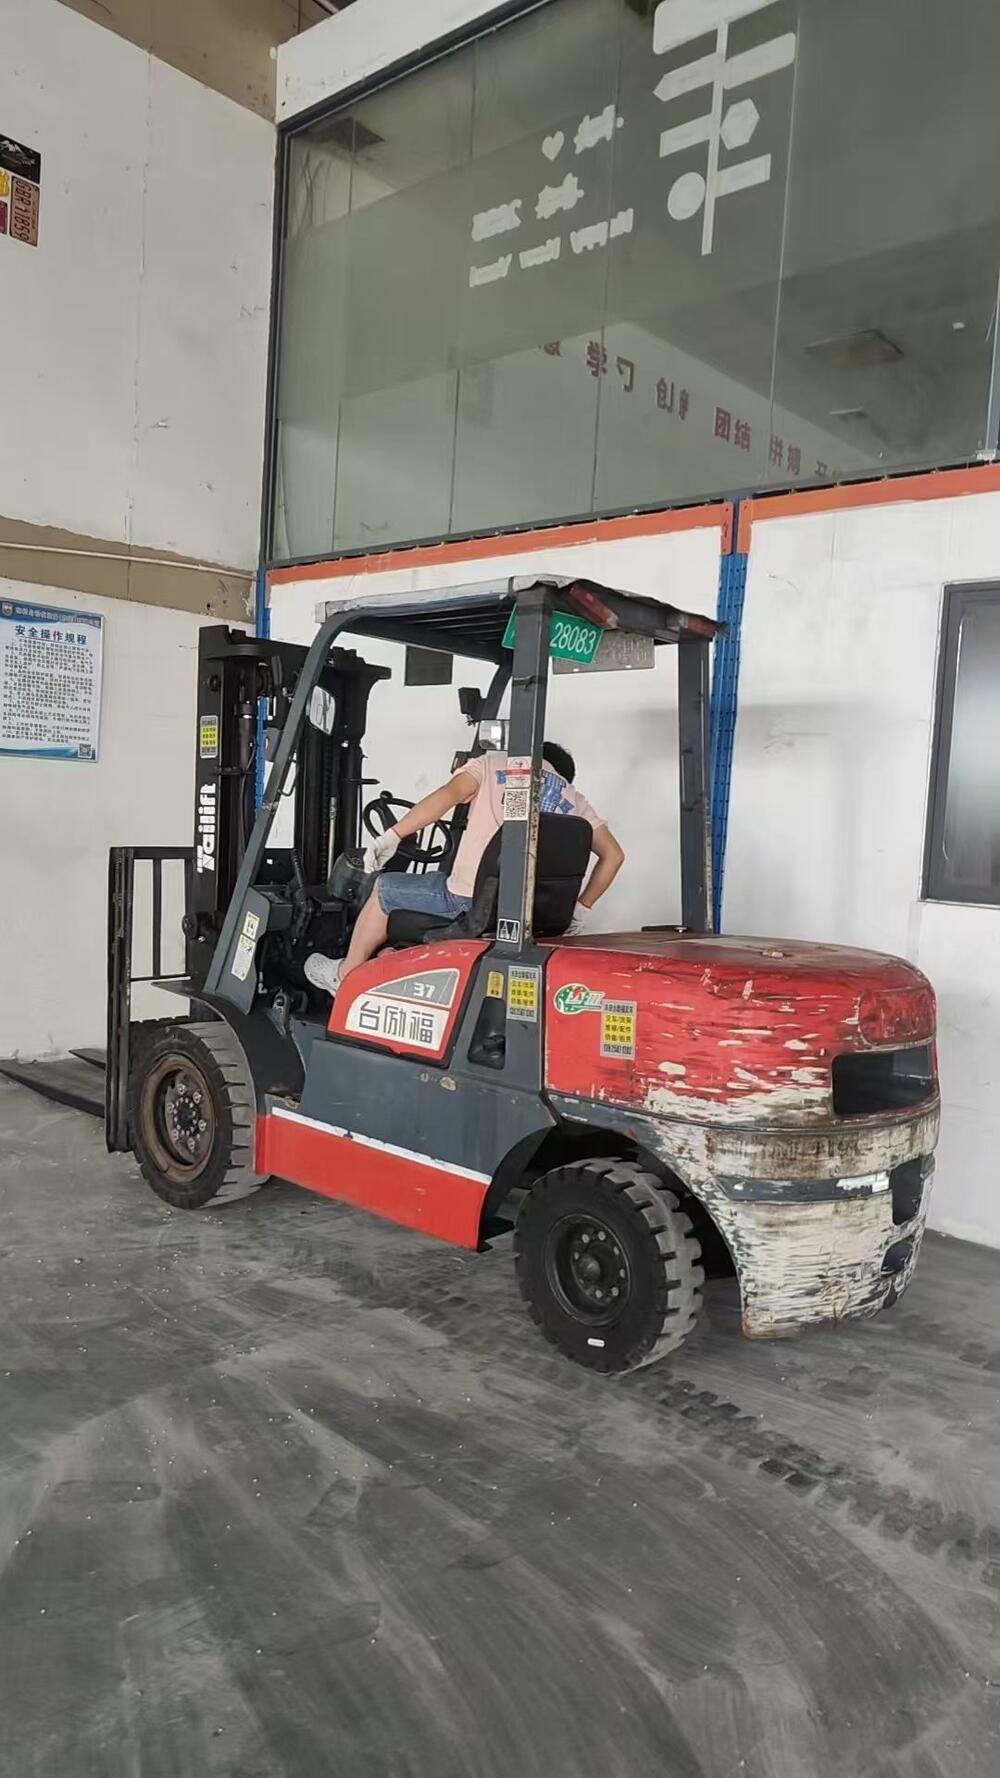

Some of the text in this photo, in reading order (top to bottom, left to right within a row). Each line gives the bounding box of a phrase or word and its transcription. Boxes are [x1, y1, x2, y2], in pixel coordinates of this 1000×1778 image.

[714, 407, 751, 452] 团结
[15, 624, 87, 645] 安全操作规程
[549, 622, 597, 655] 28083
[196, 783, 216, 873] Tailift
[413, 982, 435, 998] 37
[359, 1001, 434, 1044] 台励福
